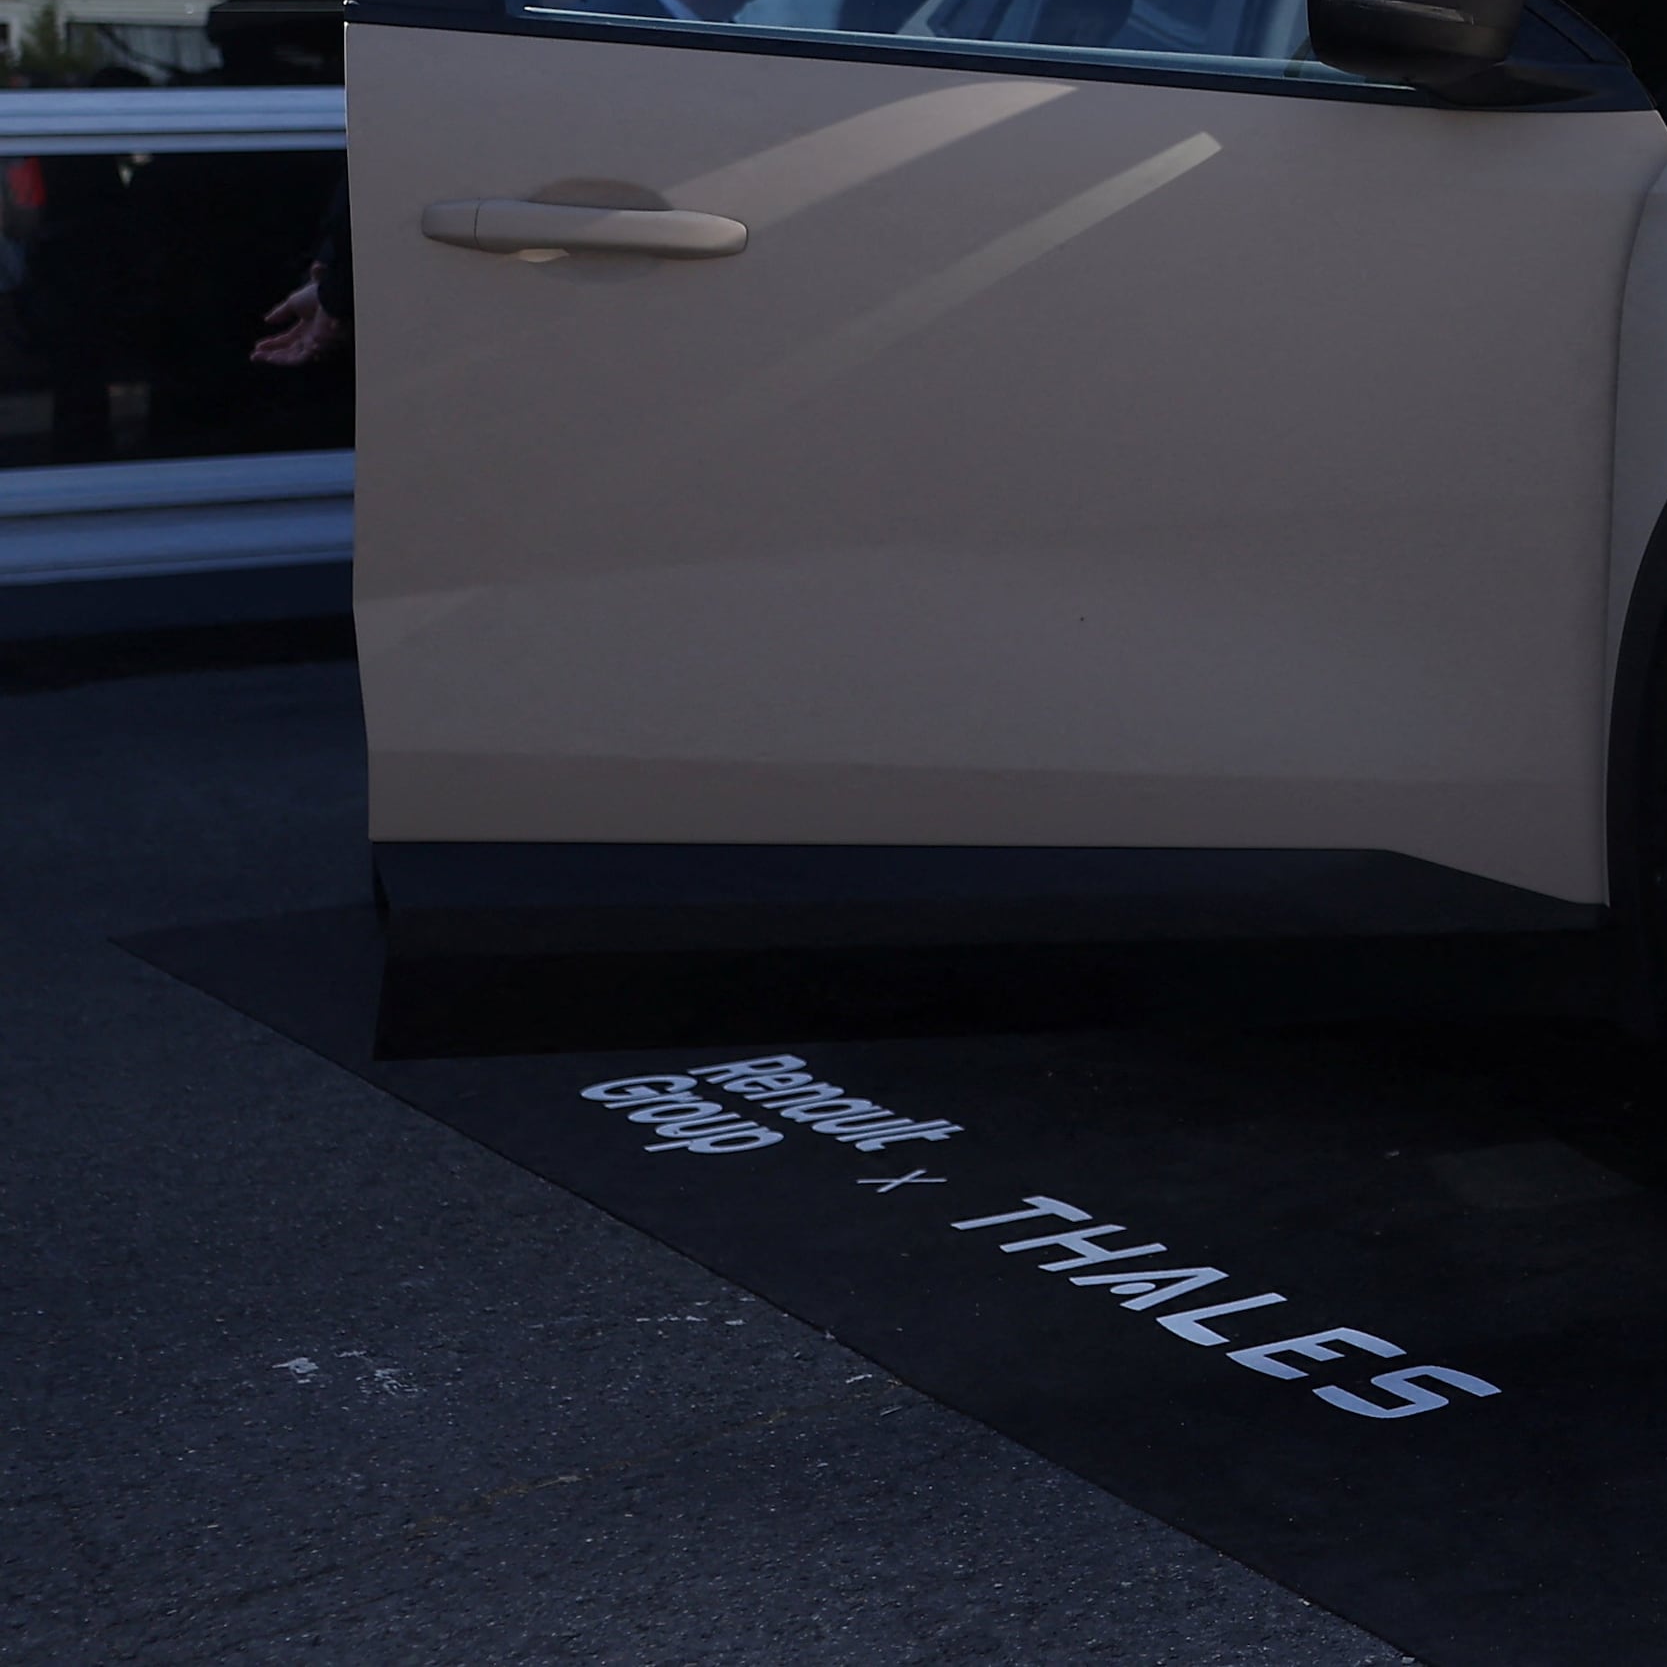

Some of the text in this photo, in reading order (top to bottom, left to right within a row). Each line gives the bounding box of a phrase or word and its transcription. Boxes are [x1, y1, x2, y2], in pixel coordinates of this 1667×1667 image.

[580, 1074, 785, 1154] Group
[687, 1054, 965, 1152] Renault
[950, 1195, 1502, 1419] THALES
